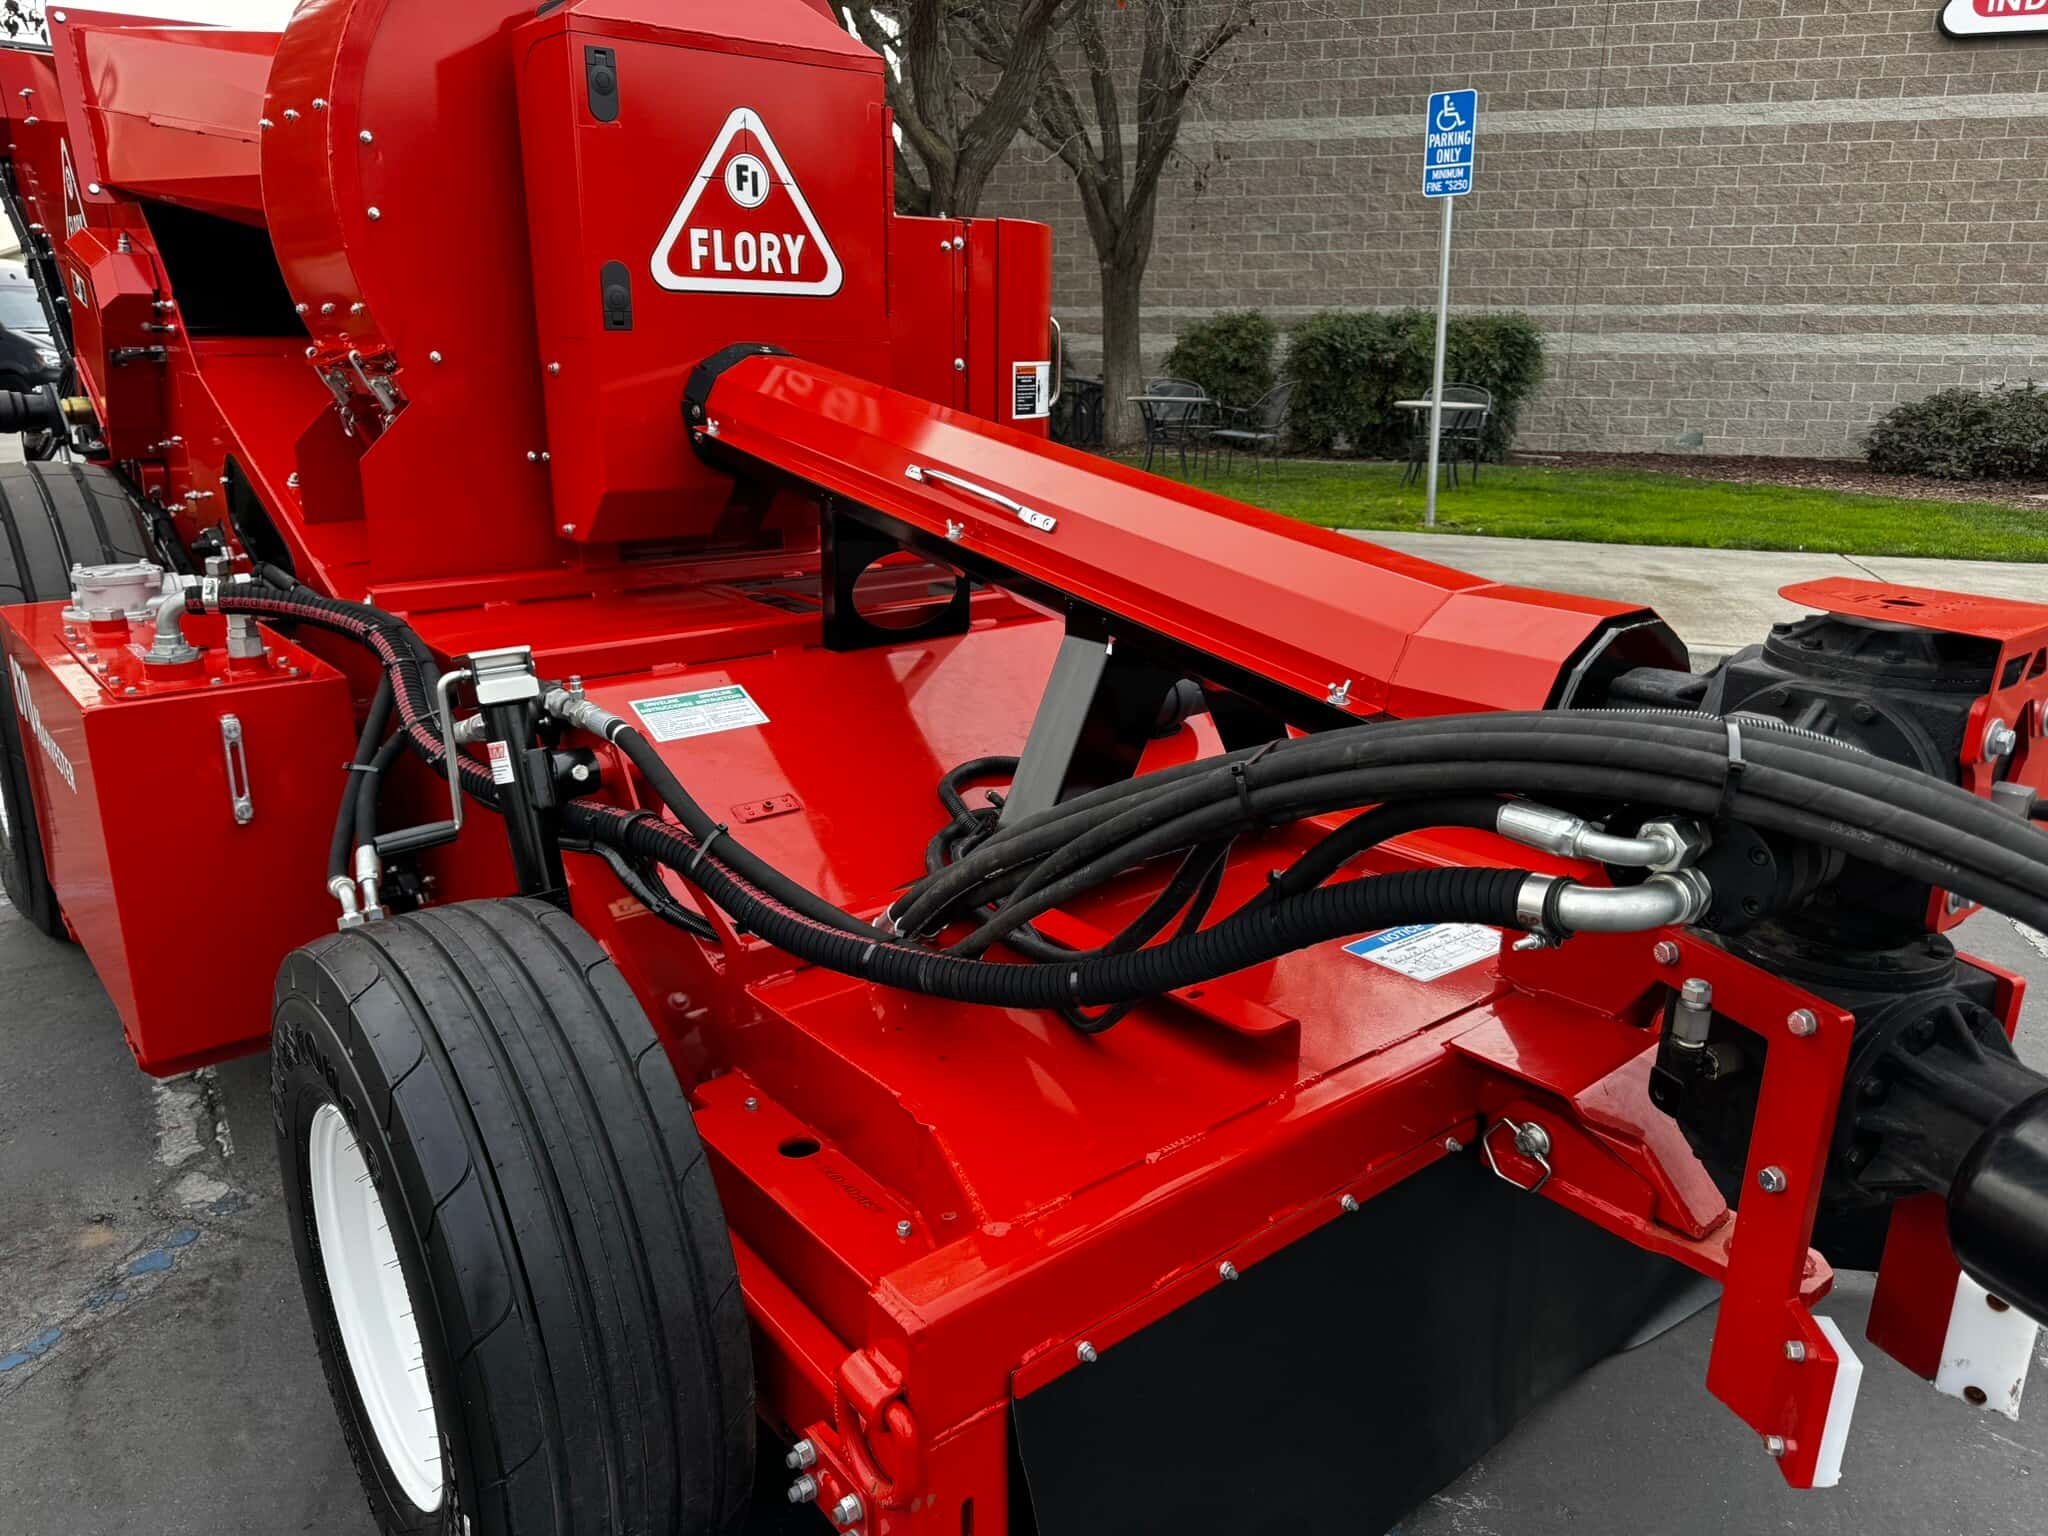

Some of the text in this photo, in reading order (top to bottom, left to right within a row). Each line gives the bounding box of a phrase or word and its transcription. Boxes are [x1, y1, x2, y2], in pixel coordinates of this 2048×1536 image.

[1428, 130, 1471, 148] PARKING
[1436, 147, 1462, 164] ONLY
[1432, 168, 1464, 179] MINIMUM
[1426, 181, 1443, 193] FINE
[690, 228, 806, 275] FLORY
[1378, 924, 1424, 943] NOTICE
